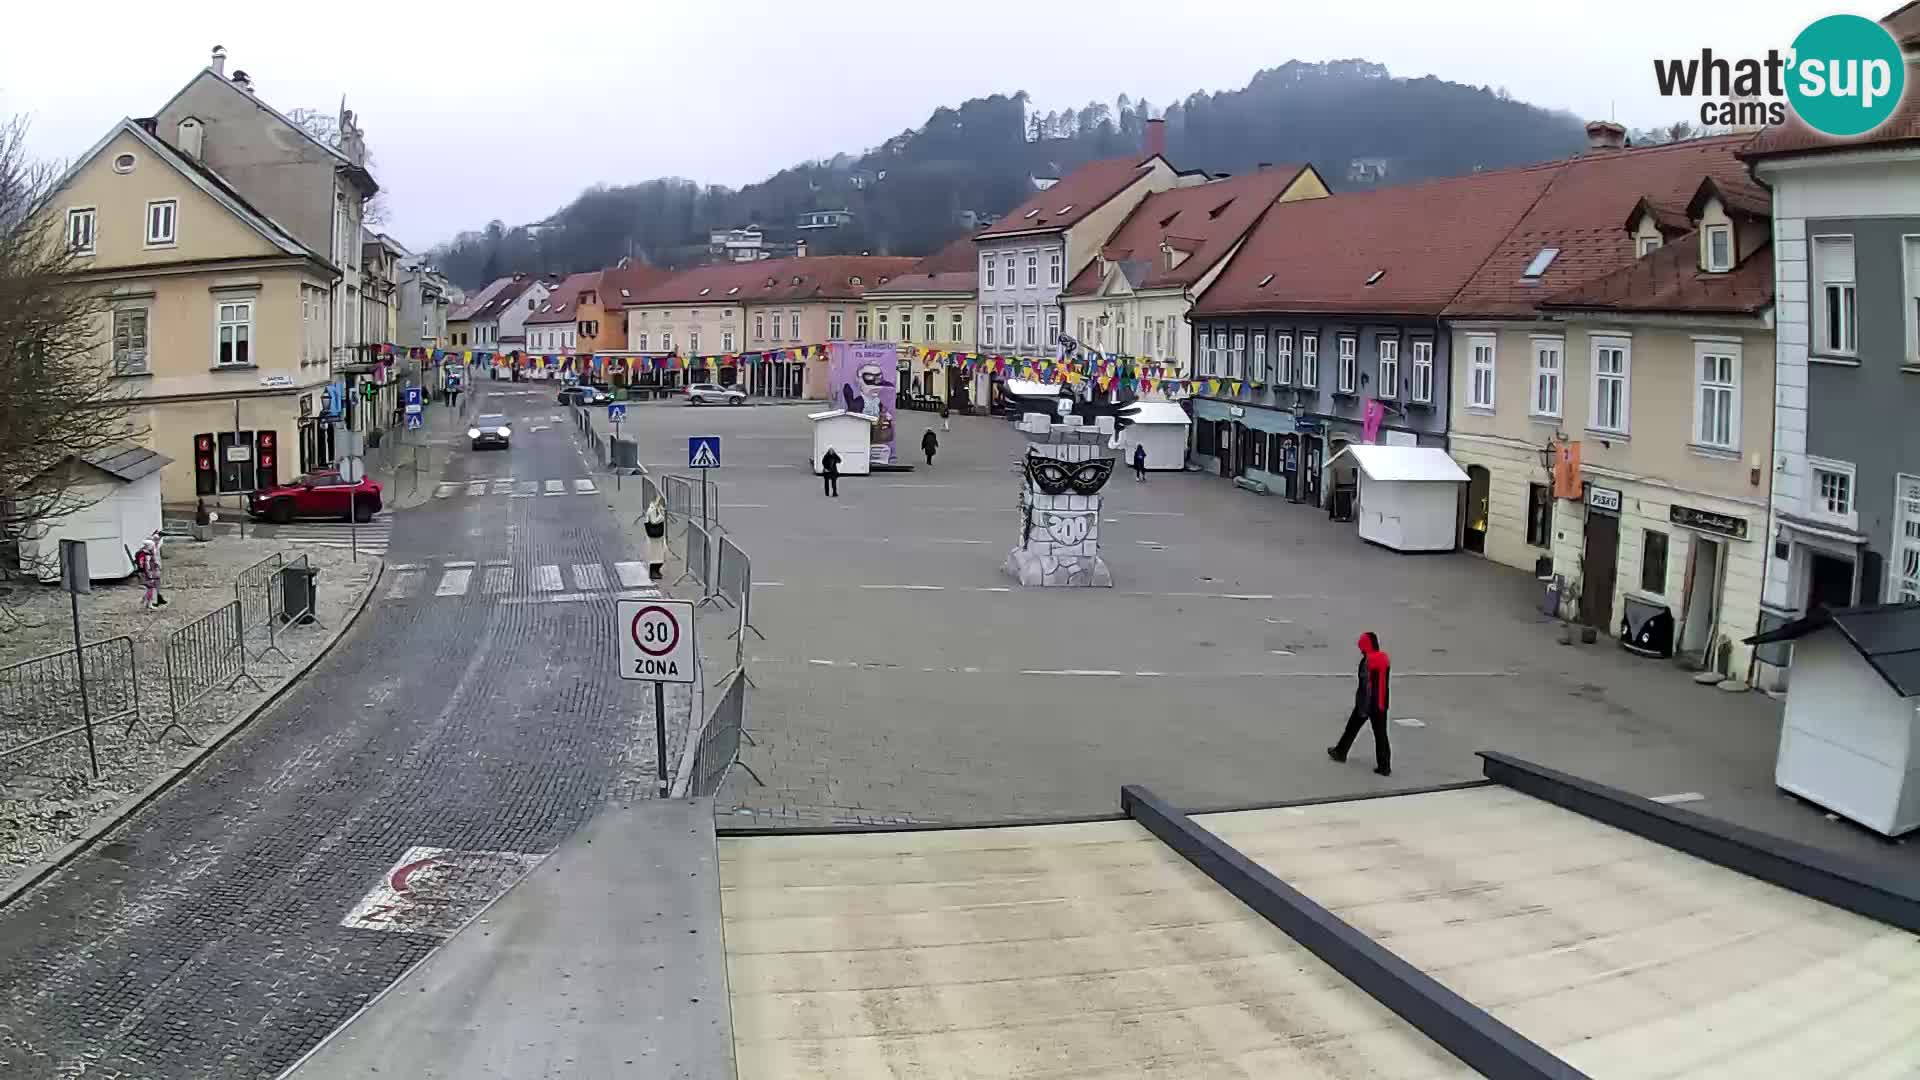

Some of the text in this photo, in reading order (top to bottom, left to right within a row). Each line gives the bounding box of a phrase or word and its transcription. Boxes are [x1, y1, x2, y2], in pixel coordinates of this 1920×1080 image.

[409, 391, 417, 402] P
[1048, 516, 1088, 545] 200
[644, 621, 668, 643] 30
[634, 659, 679, 675] ZONA
